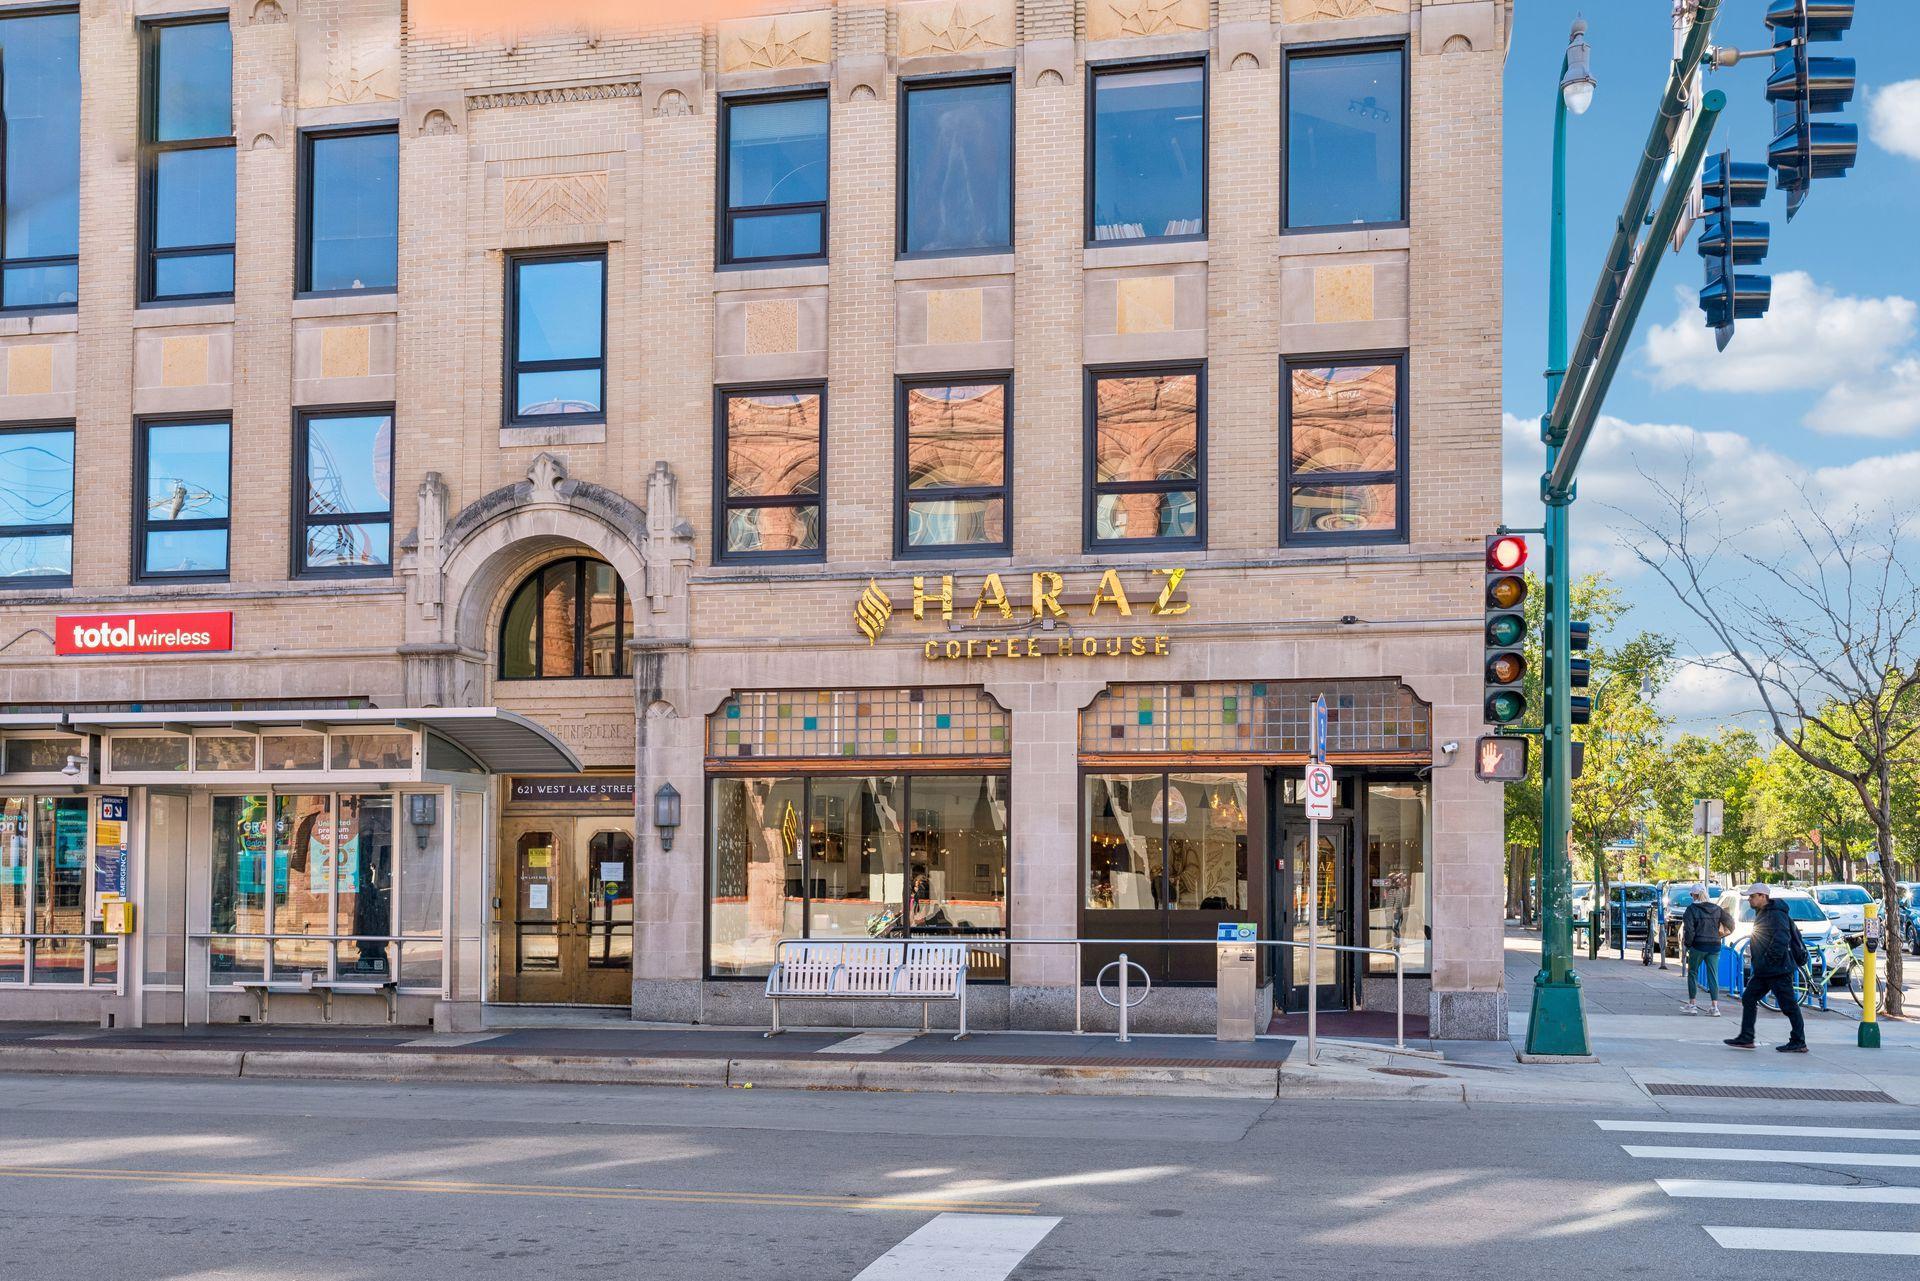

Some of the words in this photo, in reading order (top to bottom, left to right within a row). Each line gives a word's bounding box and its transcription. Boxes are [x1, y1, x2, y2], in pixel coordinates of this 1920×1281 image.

[913, 568, 1192, 621] HARAZ
[73, 619, 135, 648] total
[138, 629, 211, 646] wireless
[925, 636, 1042, 660] COFFEE
[1058, 635, 1169, 657] HOUSE
[517, 785, 533, 794] 621
[537, 785, 566, 794] WEST
[569, 785, 597, 793] LAKE
[600, 785, 637, 793] STREE
[1296, 861, 1332, 871] HAAZ
